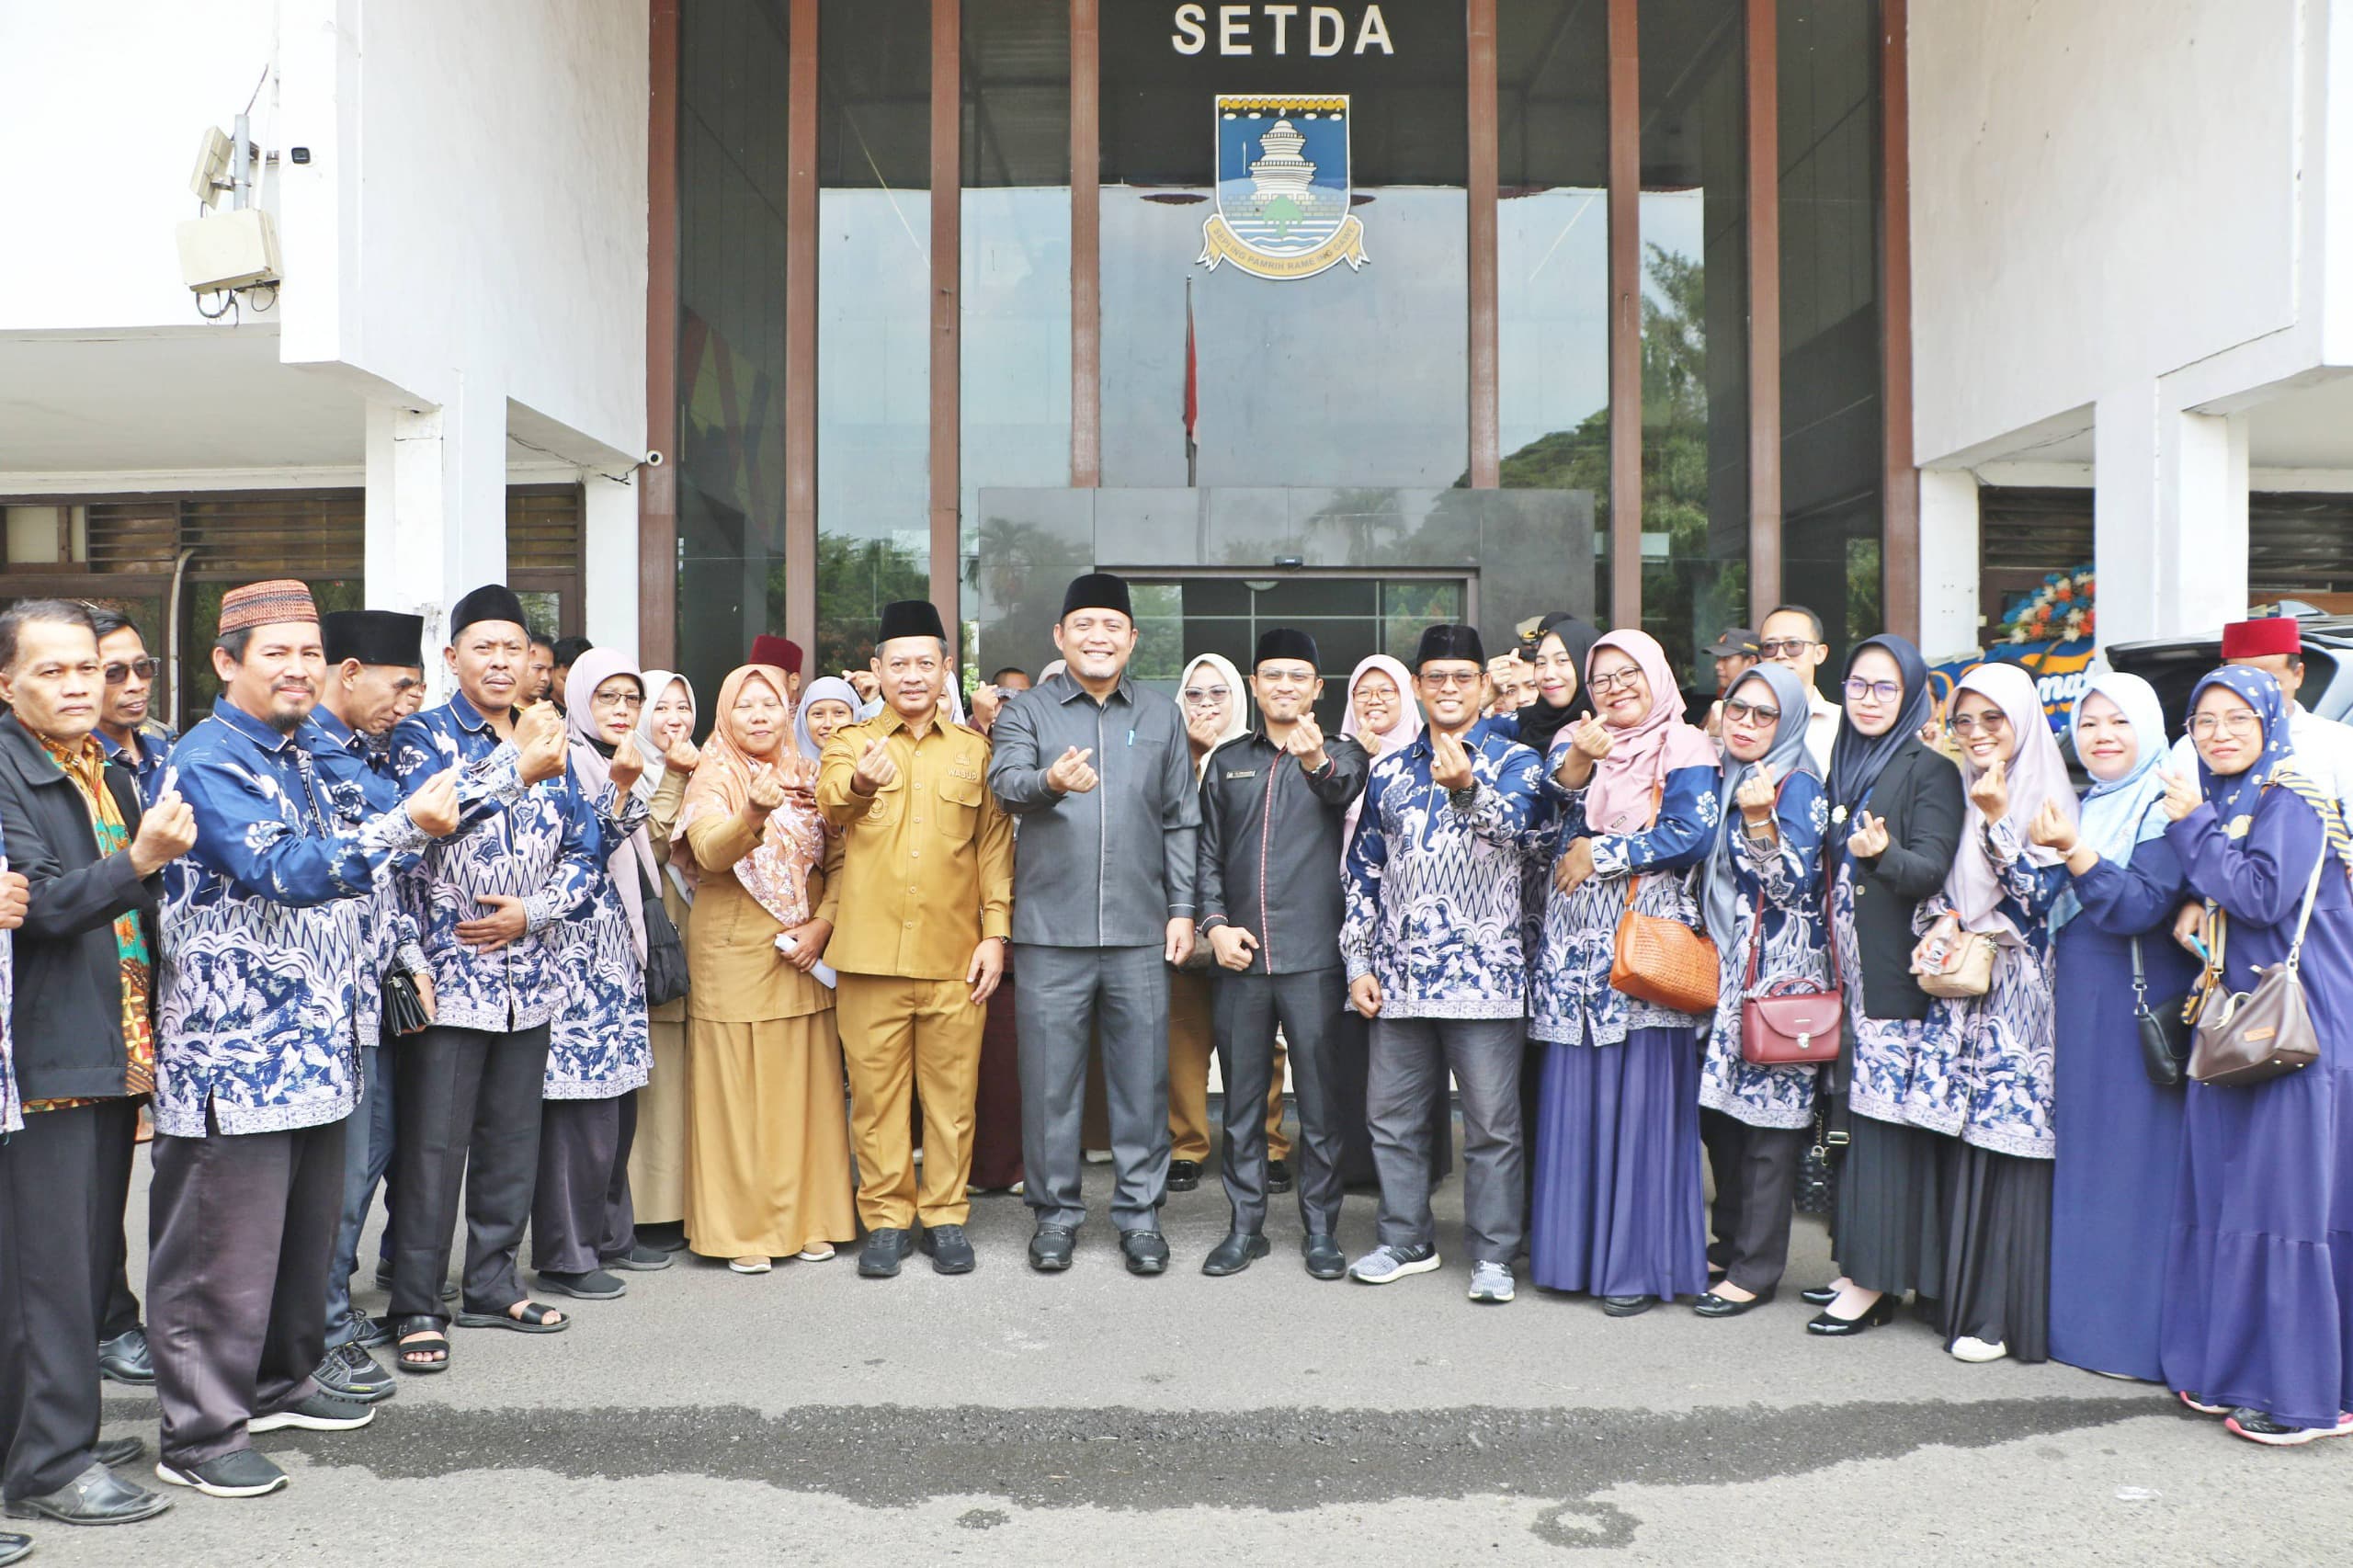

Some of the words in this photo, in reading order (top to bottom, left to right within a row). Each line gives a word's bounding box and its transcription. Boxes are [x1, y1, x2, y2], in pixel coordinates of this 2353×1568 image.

[1172, 4, 1394, 56] SETDA
[1213, 227, 1232, 248] SEPI
[1230, 246, 1247, 260] ING
[1247, 255, 1285, 270] PAMRIH
[1287, 258, 1316, 270] RAME
